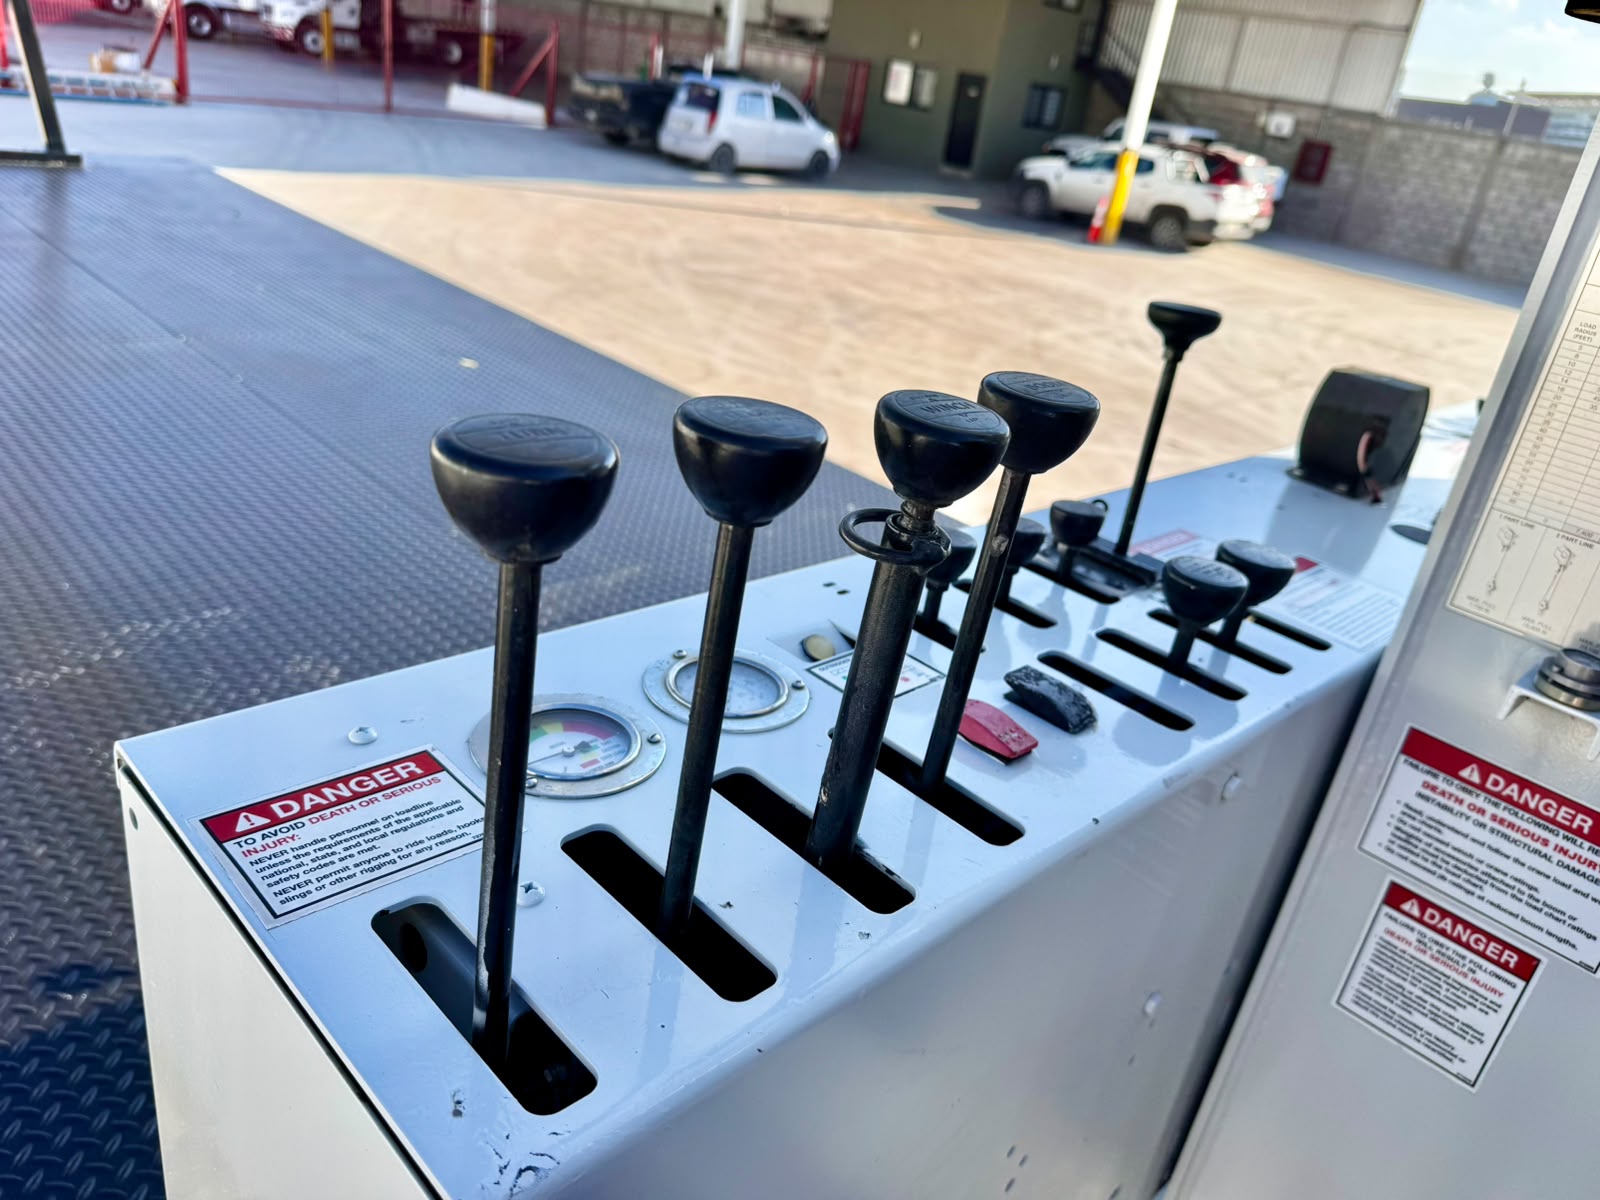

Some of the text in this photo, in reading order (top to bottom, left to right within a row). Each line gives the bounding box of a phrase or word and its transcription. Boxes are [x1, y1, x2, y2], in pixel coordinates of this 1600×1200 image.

[1580, 322, 1596, 330] LOAD
[920, 402, 976, 414] WINCH
[233, 776, 442, 848] TO AVOID DEATH OR SERIOUS
[269, 760, 424, 818] DANGER
[1402, 758, 1440, 781] FAILURE
[1440, 776, 1454, 787] TO
[1454, 782, 1481, 800] OBEY
[1481, 795, 1502, 810] THE
[1502, 804, 1560, 837] FOLLOWING
[1560, 832, 1587, 850] WILL
[1484, 772, 1594, 834] DANGER
[240, 832, 302, 857] INJURY:
[248, 849, 289, 866] NEVER
[289, 836, 327, 852] handle
[327, 818, 380, 840] personnel
[394, 800, 434, 816] loadline
[254, 856, 292, 873] unless
[292, 850, 311, 860] the
[311, 825, 382, 854] requirements
[393, 815, 412, 824] the
[411, 798, 462, 819] applicable
[259, 805, 464, 881] national, state, and local regulations and
[1414, 790, 1471, 823] INSTABILITY
[1471, 817, 1488, 831] OR
[1487, 825, 1554, 863] STRUCTURAL
[1420, 780, 1600, 873] DEATH OR SERIOUS INJUR
[265, 843, 381, 889] safety codes are met.
[272, 878, 314, 897] NEVER
[314, 865, 352, 883] permit
[352, 851, 392, 869] anyone
[403, 838, 425, 849] ride
[424, 826, 457, 842] loads,
[277, 888, 314, 906] slings
[327, 871, 358, 886] other
[358, 857, 398, 876] rigging
[396, 851, 413, 860] for
[413, 844, 433, 855] any
[433, 830, 471, 846] reason.
[1421, 906, 1520, 969] DANGER
[1475, 892, 1485, 902] at
[1485, 898, 1520, 920] reduced
[1519, 915, 1544, 933] boom
[1543, 928, 1579, 952] lengths.
[1488, 881, 1509, 896] from
[1509, 892, 1523, 904] the
[1523, 899, 1543, 914] load
[1543, 909, 1567, 926] chart
[1566, 921, 1598, 943] ratings
[1383, 927, 1412, 948] DEATH
[1412, 943, 1427, 956] OR
[1428, 952, 1469, 979] SERIOUS
[1469, 975, 1504, 998] INJURY
[1416, 930, 1427, 939] TO
[1427, 936, 1450, 952] OBEY
[1451, 948, 1467, 961] THE
[1468, 958, 1517, 989] FOLLOWING
[1434, 948, 1466, 969] RESULT
[1466, 965, 1476, 974] IN
